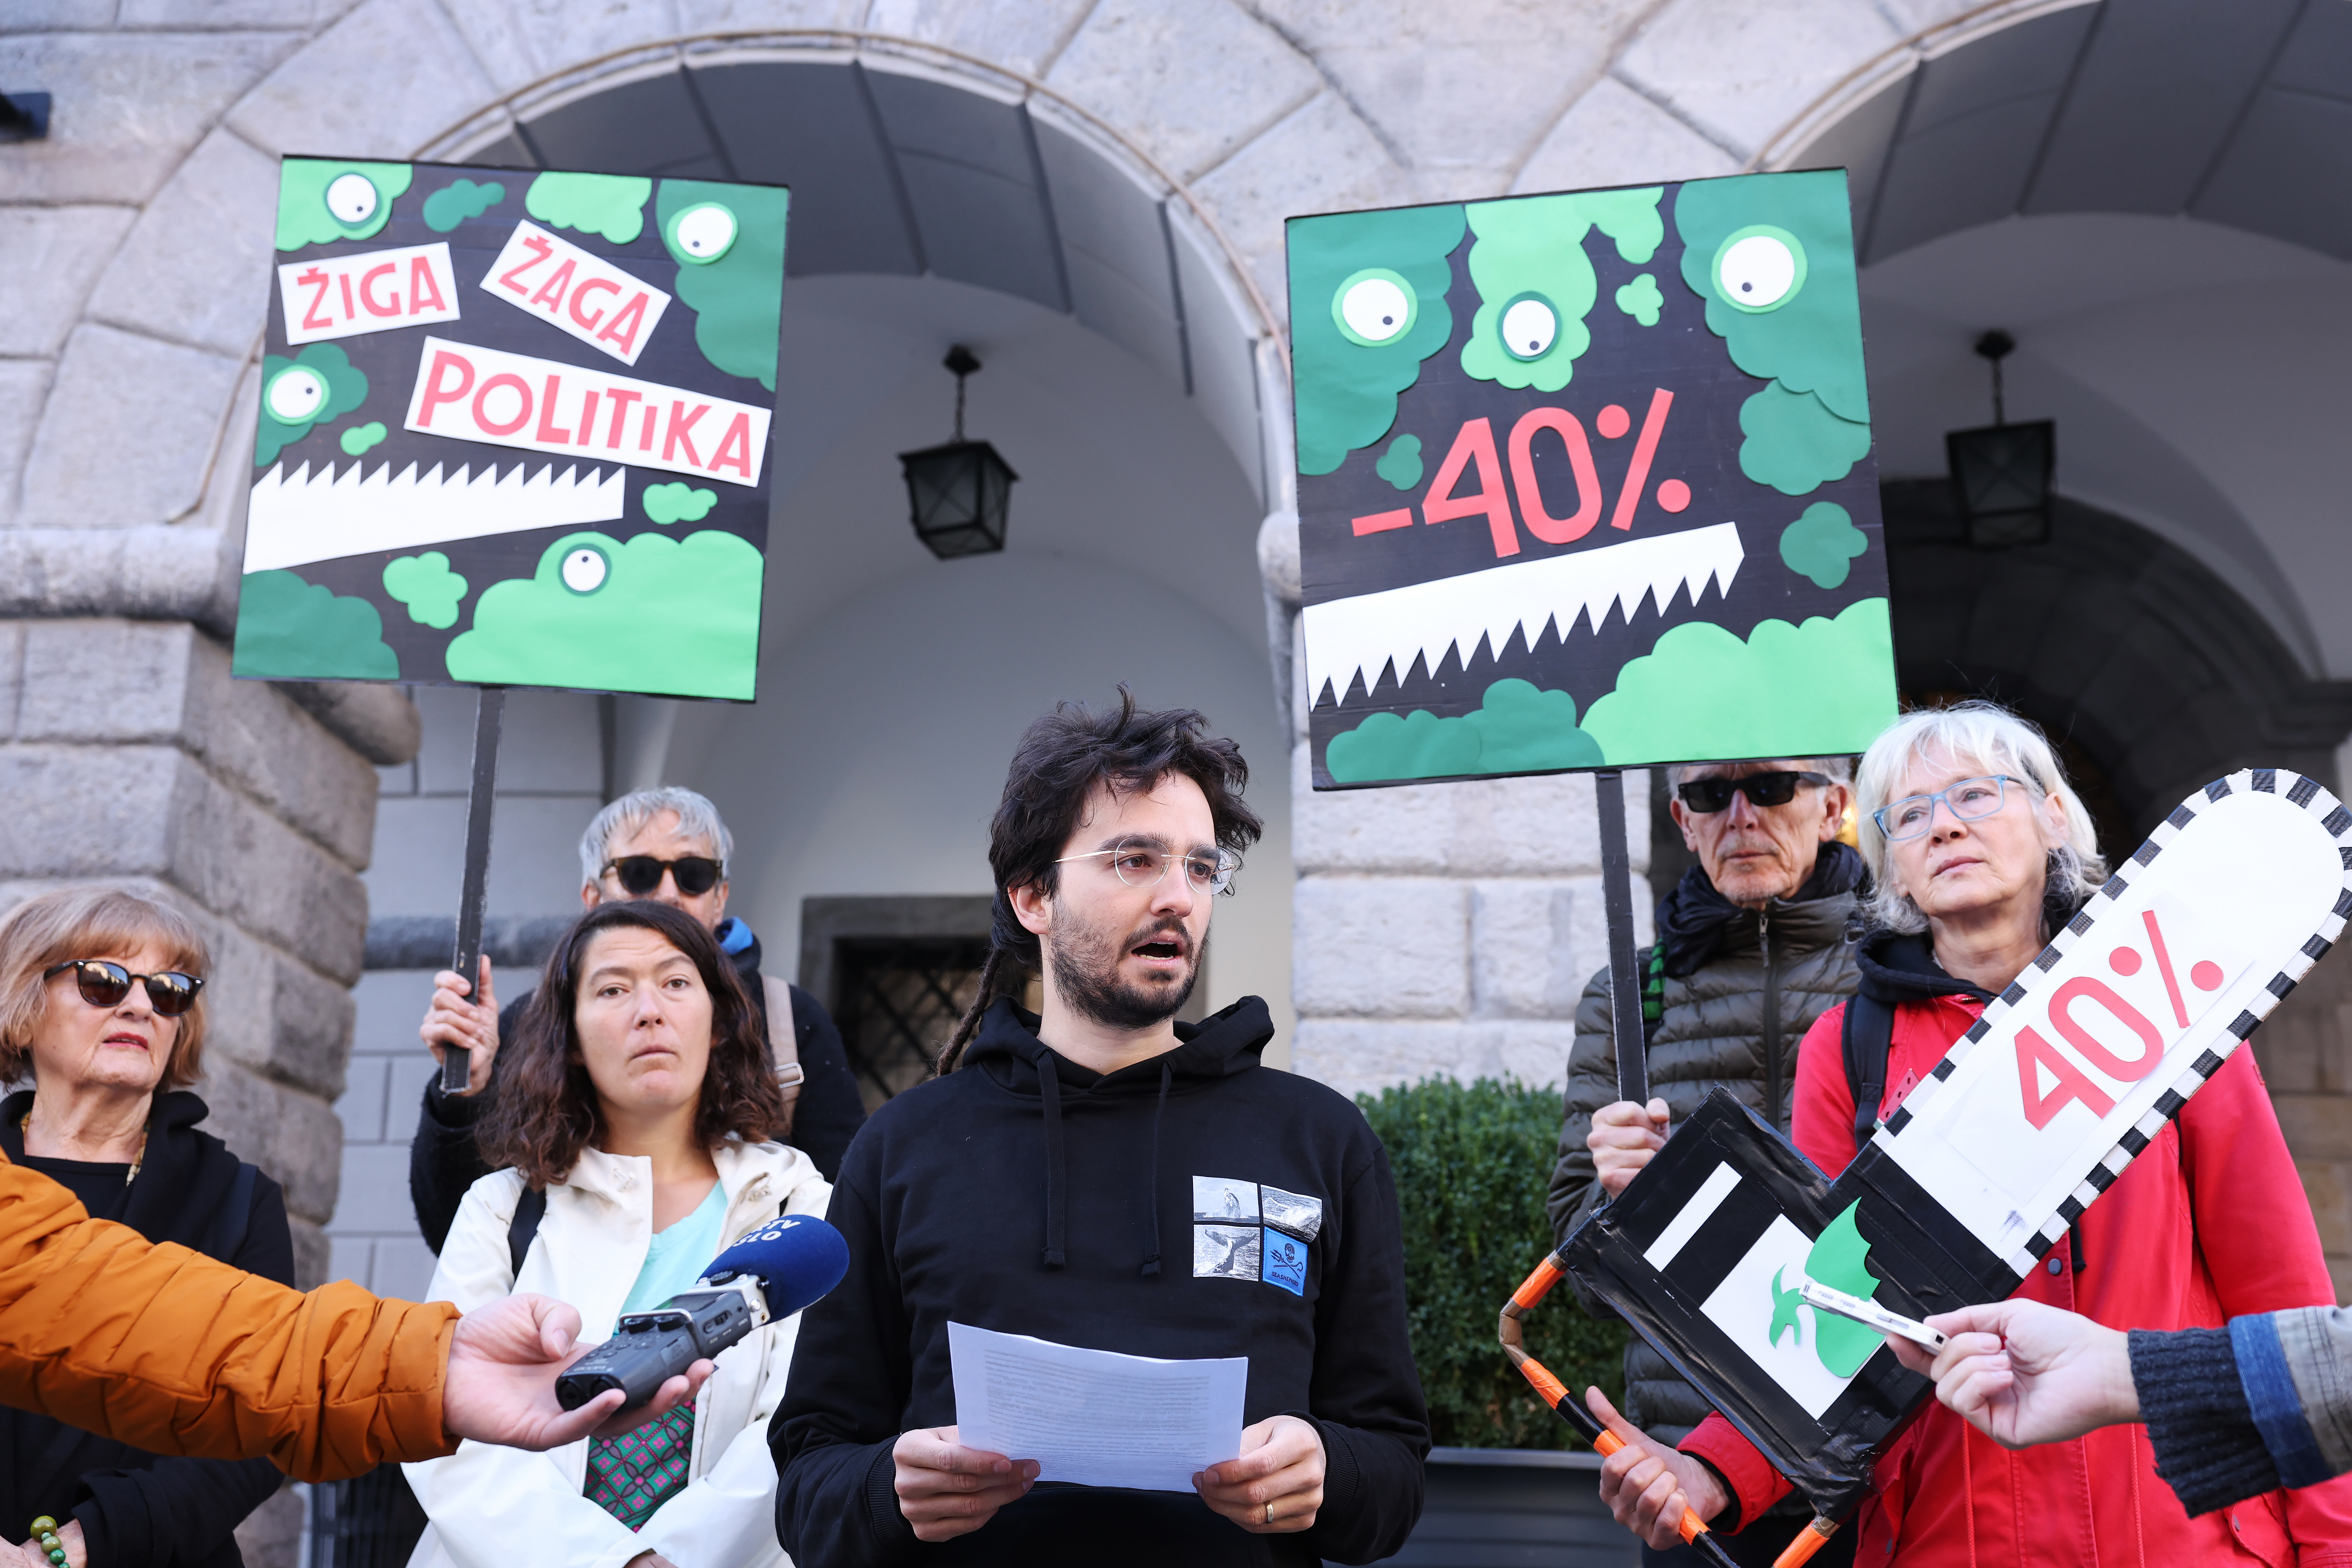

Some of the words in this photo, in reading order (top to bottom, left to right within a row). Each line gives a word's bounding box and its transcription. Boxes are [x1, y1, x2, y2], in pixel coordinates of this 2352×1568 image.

[297, 256, 446, 330] ŽIGA
[499, 235, 650, 356] ŽAGA
[416, 350, 751, 478] POLITIKA
[1351, 388, 1691, 558] -40%
[2014, 910, 2224, 1131] 40%
[732, 1230, 782, 1247] SLO
